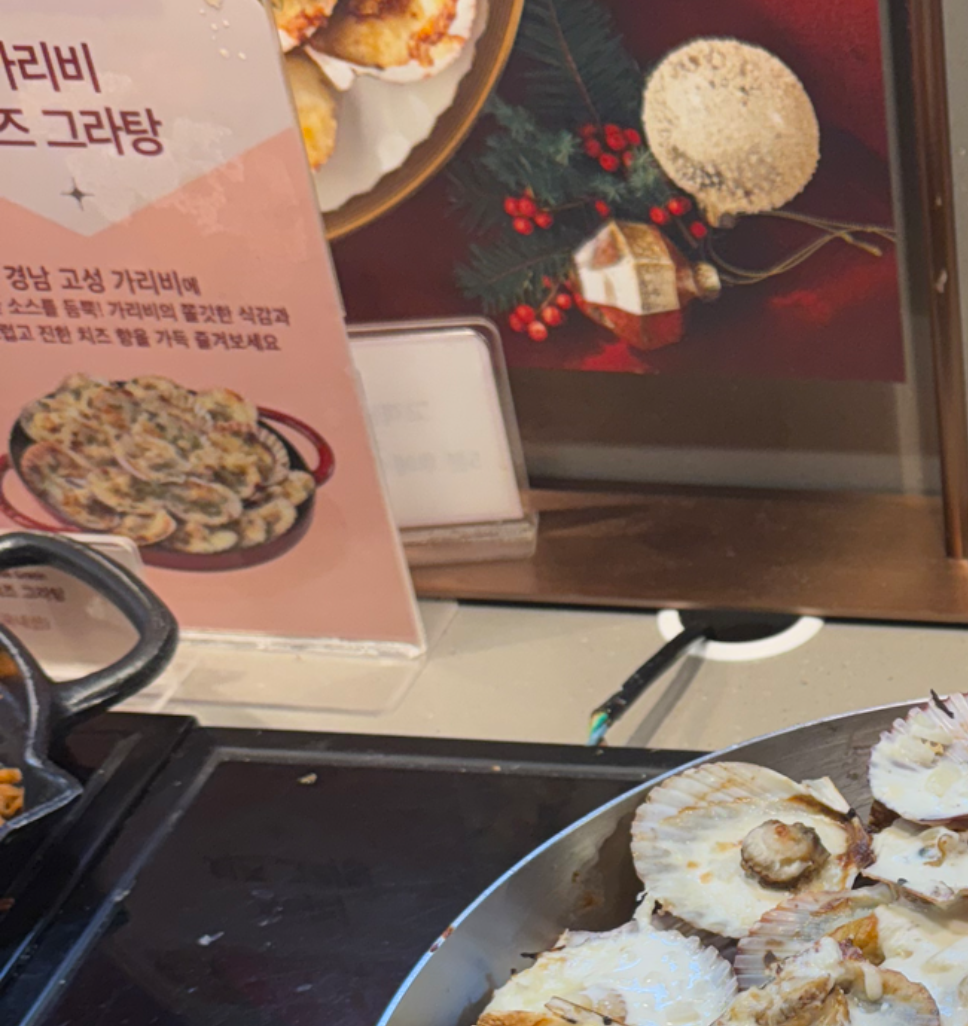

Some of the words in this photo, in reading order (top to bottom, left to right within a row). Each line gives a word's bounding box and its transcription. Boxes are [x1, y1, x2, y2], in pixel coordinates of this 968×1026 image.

[41, 106, 164, 157] 그라탕
[3, 264, 52, 292] 경남
[58, 267, 105, 294] 고성
[110, 268, 201, 297] 가리비에
[8, 297, 58, 319] 소스를
[107, 301, 178, 322] 가리비의
[238, 305, 290, 327] 식감과
[37, 324, 73, 345] 진한
[77, 325, 113, 346] 치즈
[115, 327, 151, 348] 향을
[155, 329, 190, 349] 가득
[194, 330, 281, 352] 즐겨보세요
